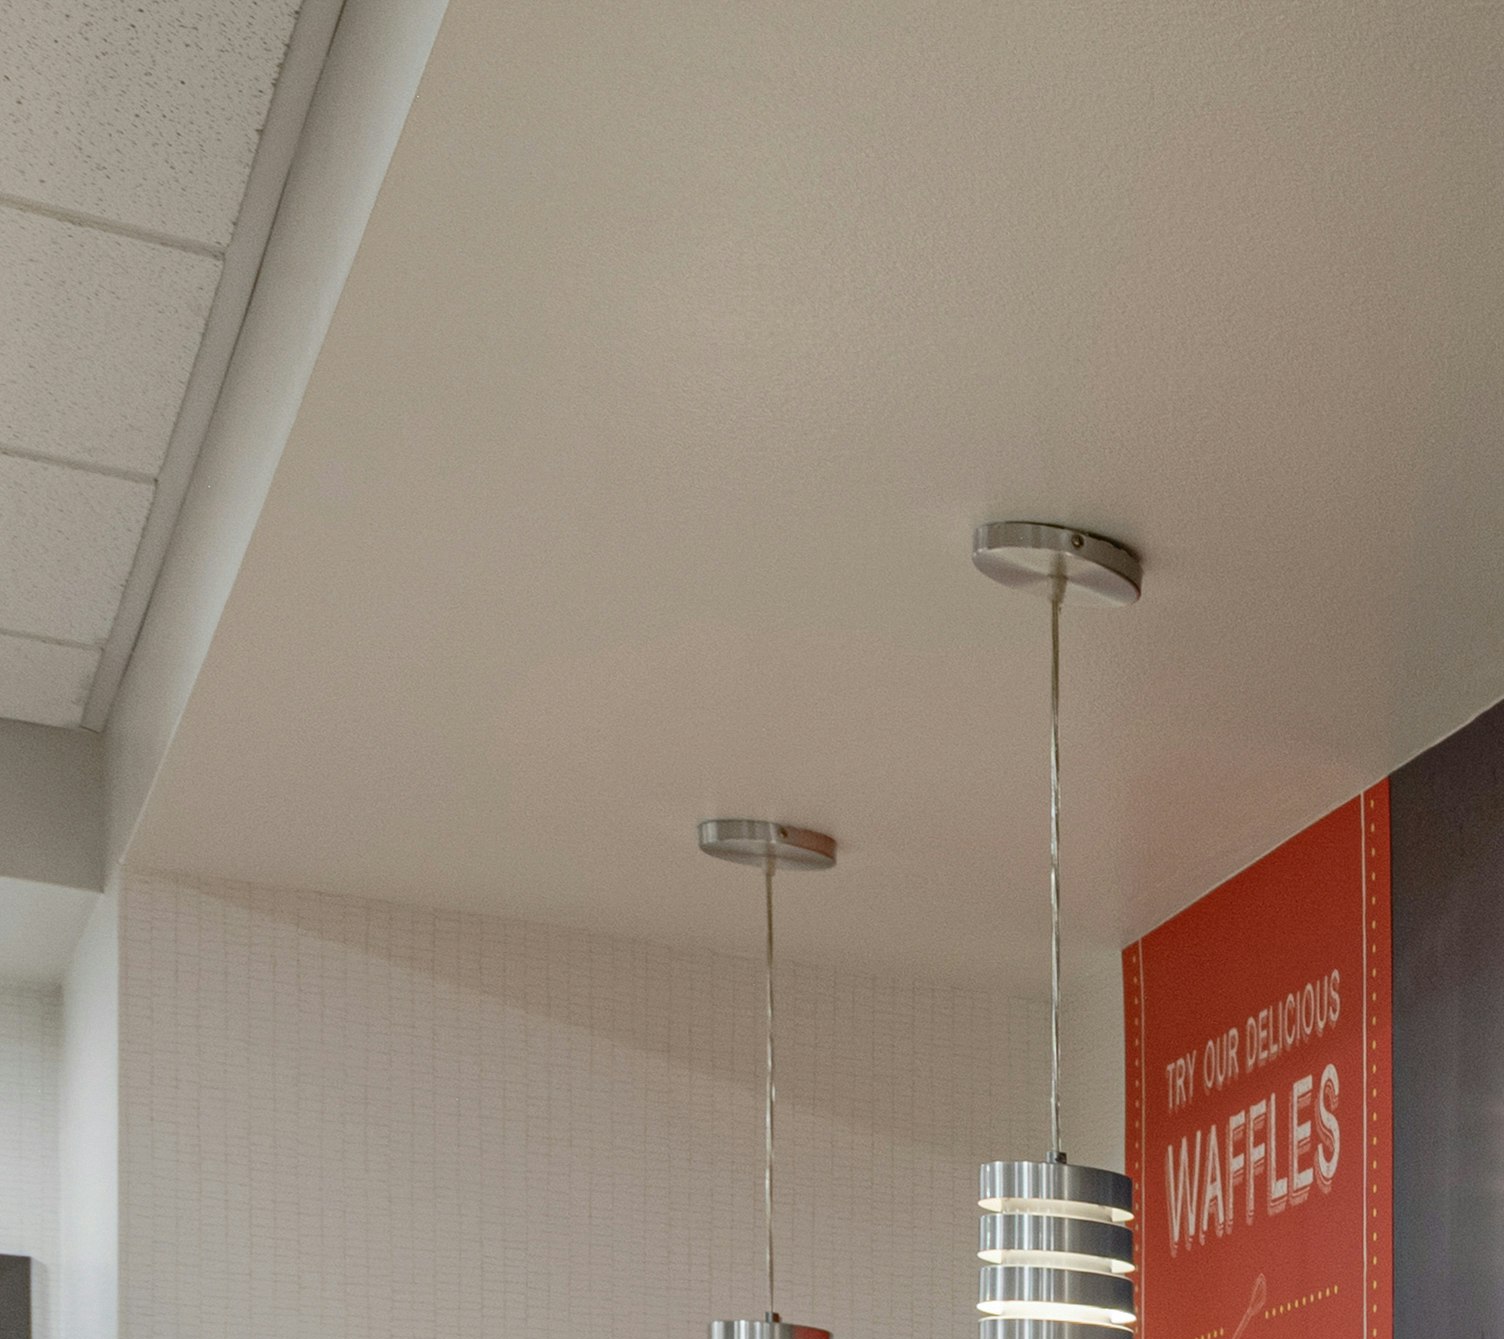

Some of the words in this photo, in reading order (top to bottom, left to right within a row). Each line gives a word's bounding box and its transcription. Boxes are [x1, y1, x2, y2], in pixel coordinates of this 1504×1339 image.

[1166, 1050, 1197, 1110] TRY
[1203, 1027, 1239, 1090] OUR
[1246, 968, 1341, 1069] DELICIOUS
[1166, 1063, 1341, 1248] WAFFLES
